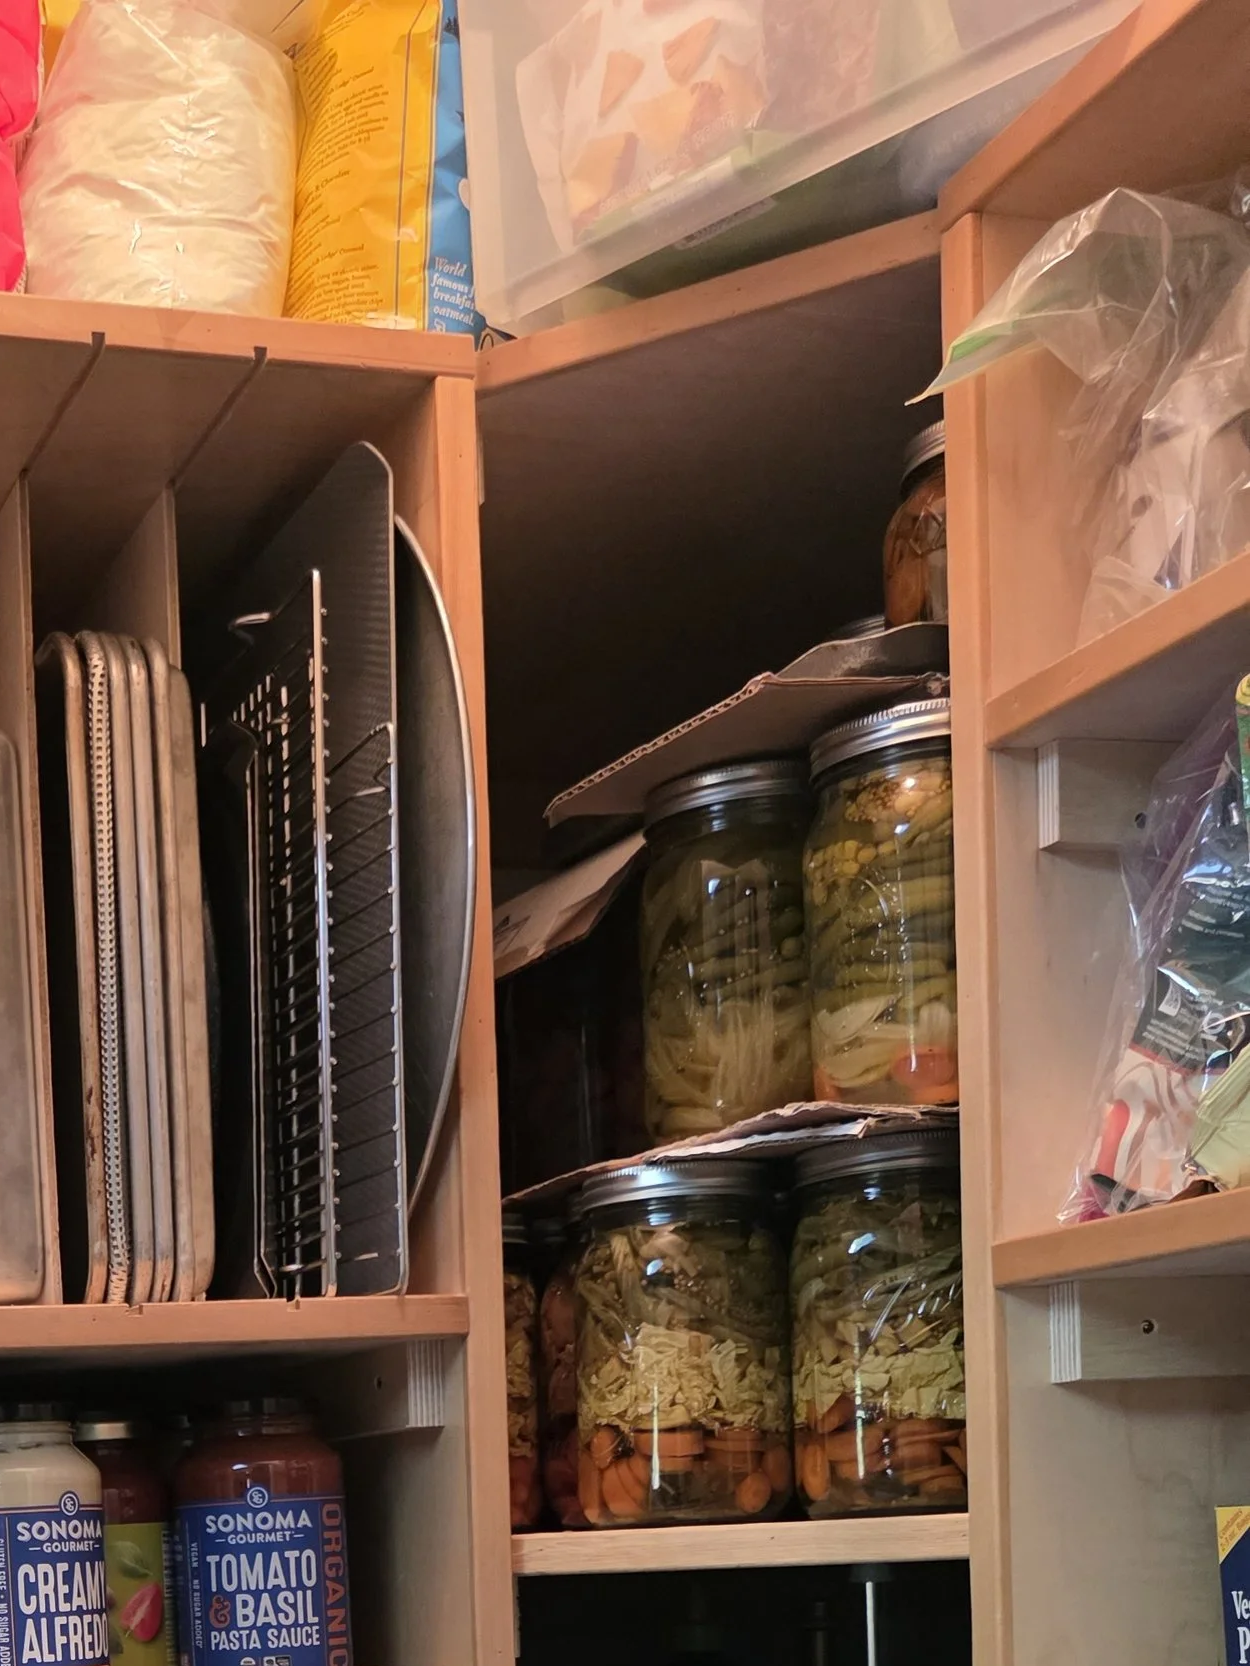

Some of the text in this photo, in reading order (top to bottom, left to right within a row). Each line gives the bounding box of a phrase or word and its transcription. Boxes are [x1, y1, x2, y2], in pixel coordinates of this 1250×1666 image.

[433, 256, 467, 278] World
[430, 272, 469, 293] famous
[16, 1519, 103, 1543] SONOMA
[205, 1509, 313, 1534] SONOMA
[42, 1539, 95, 1554] GOURMET
[227, 1531, 290, 1545] GOURMET
[206, 1548, 317, 1592] TOMATO
[17, 1560, 106, 1615] CREAMY
[236, 1590, 320, 1628] BASIL
[21, 1612, 110, 1665] ALFREDO
[211, 1625, 320, 1651] PASTA SAUCE
